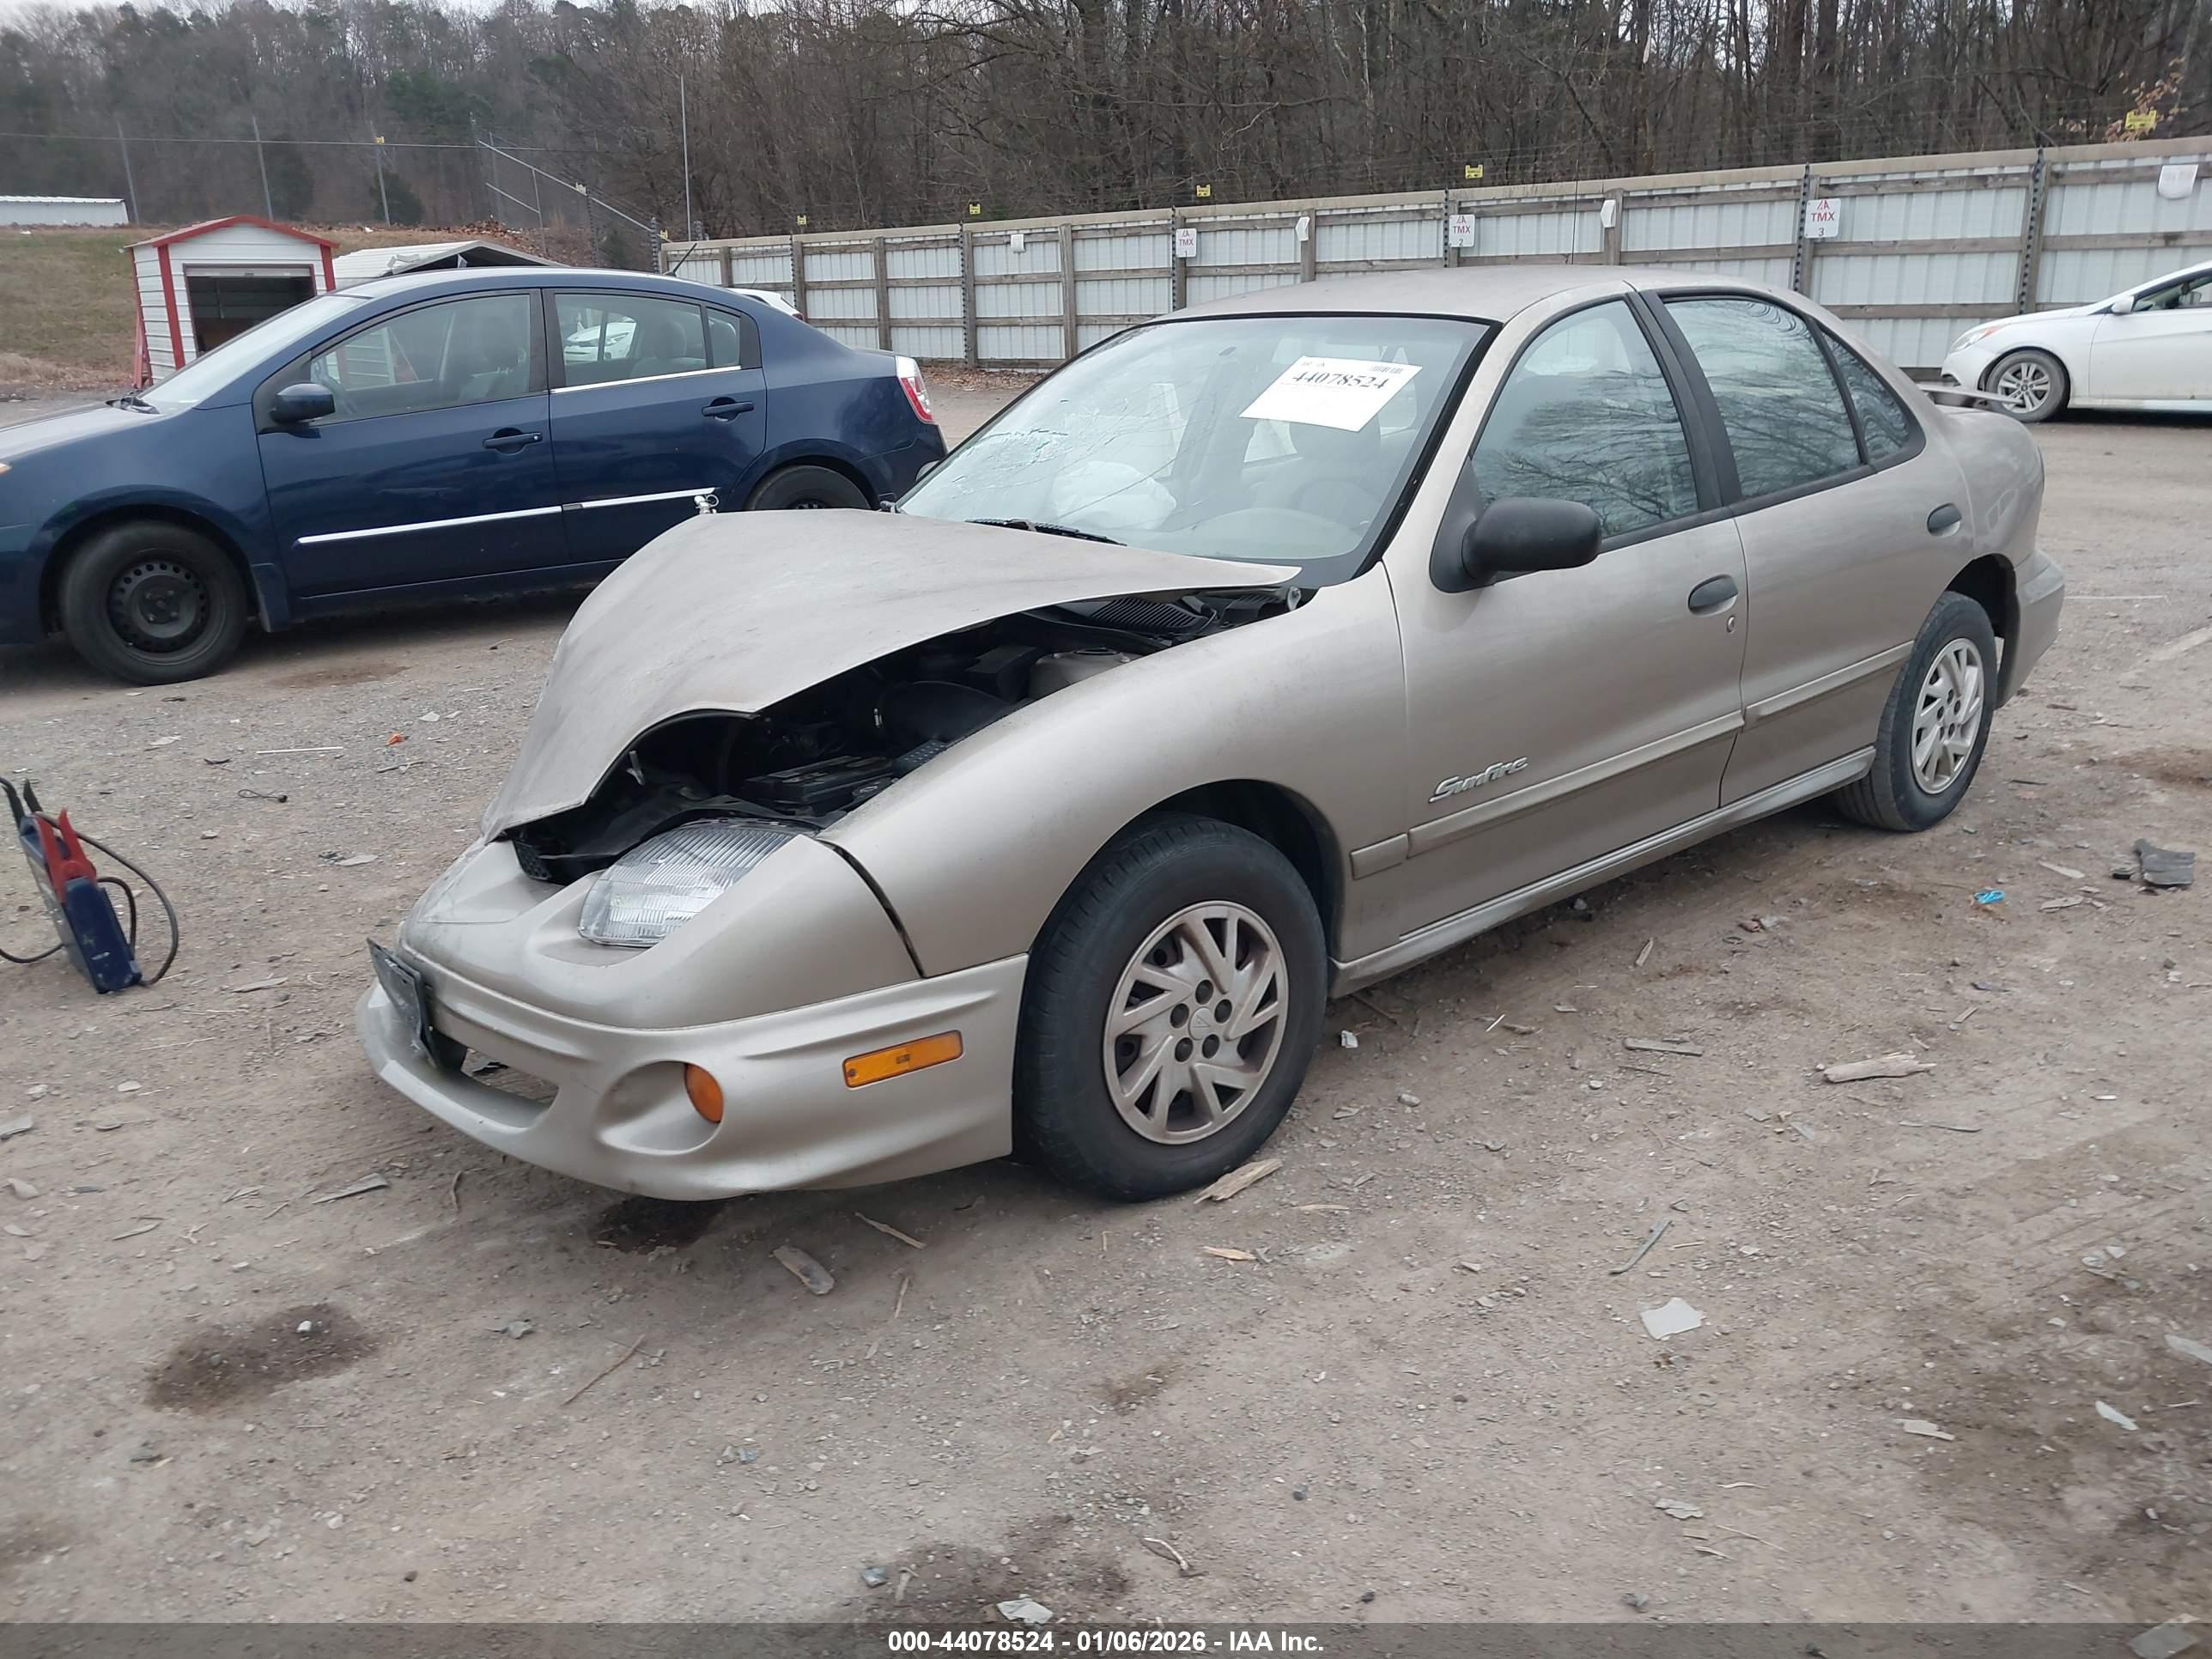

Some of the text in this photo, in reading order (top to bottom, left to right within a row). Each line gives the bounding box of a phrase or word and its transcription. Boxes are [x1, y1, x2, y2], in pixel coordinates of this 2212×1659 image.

[1811, 212, 1835, 222] TMX
[1452, 225, 1471, 234] TMX
[1819, 227, 1825, 237] 3
[1292, 371, 1389, 389] 44078524
[1428, 756, 1528, 803] Sunfire
